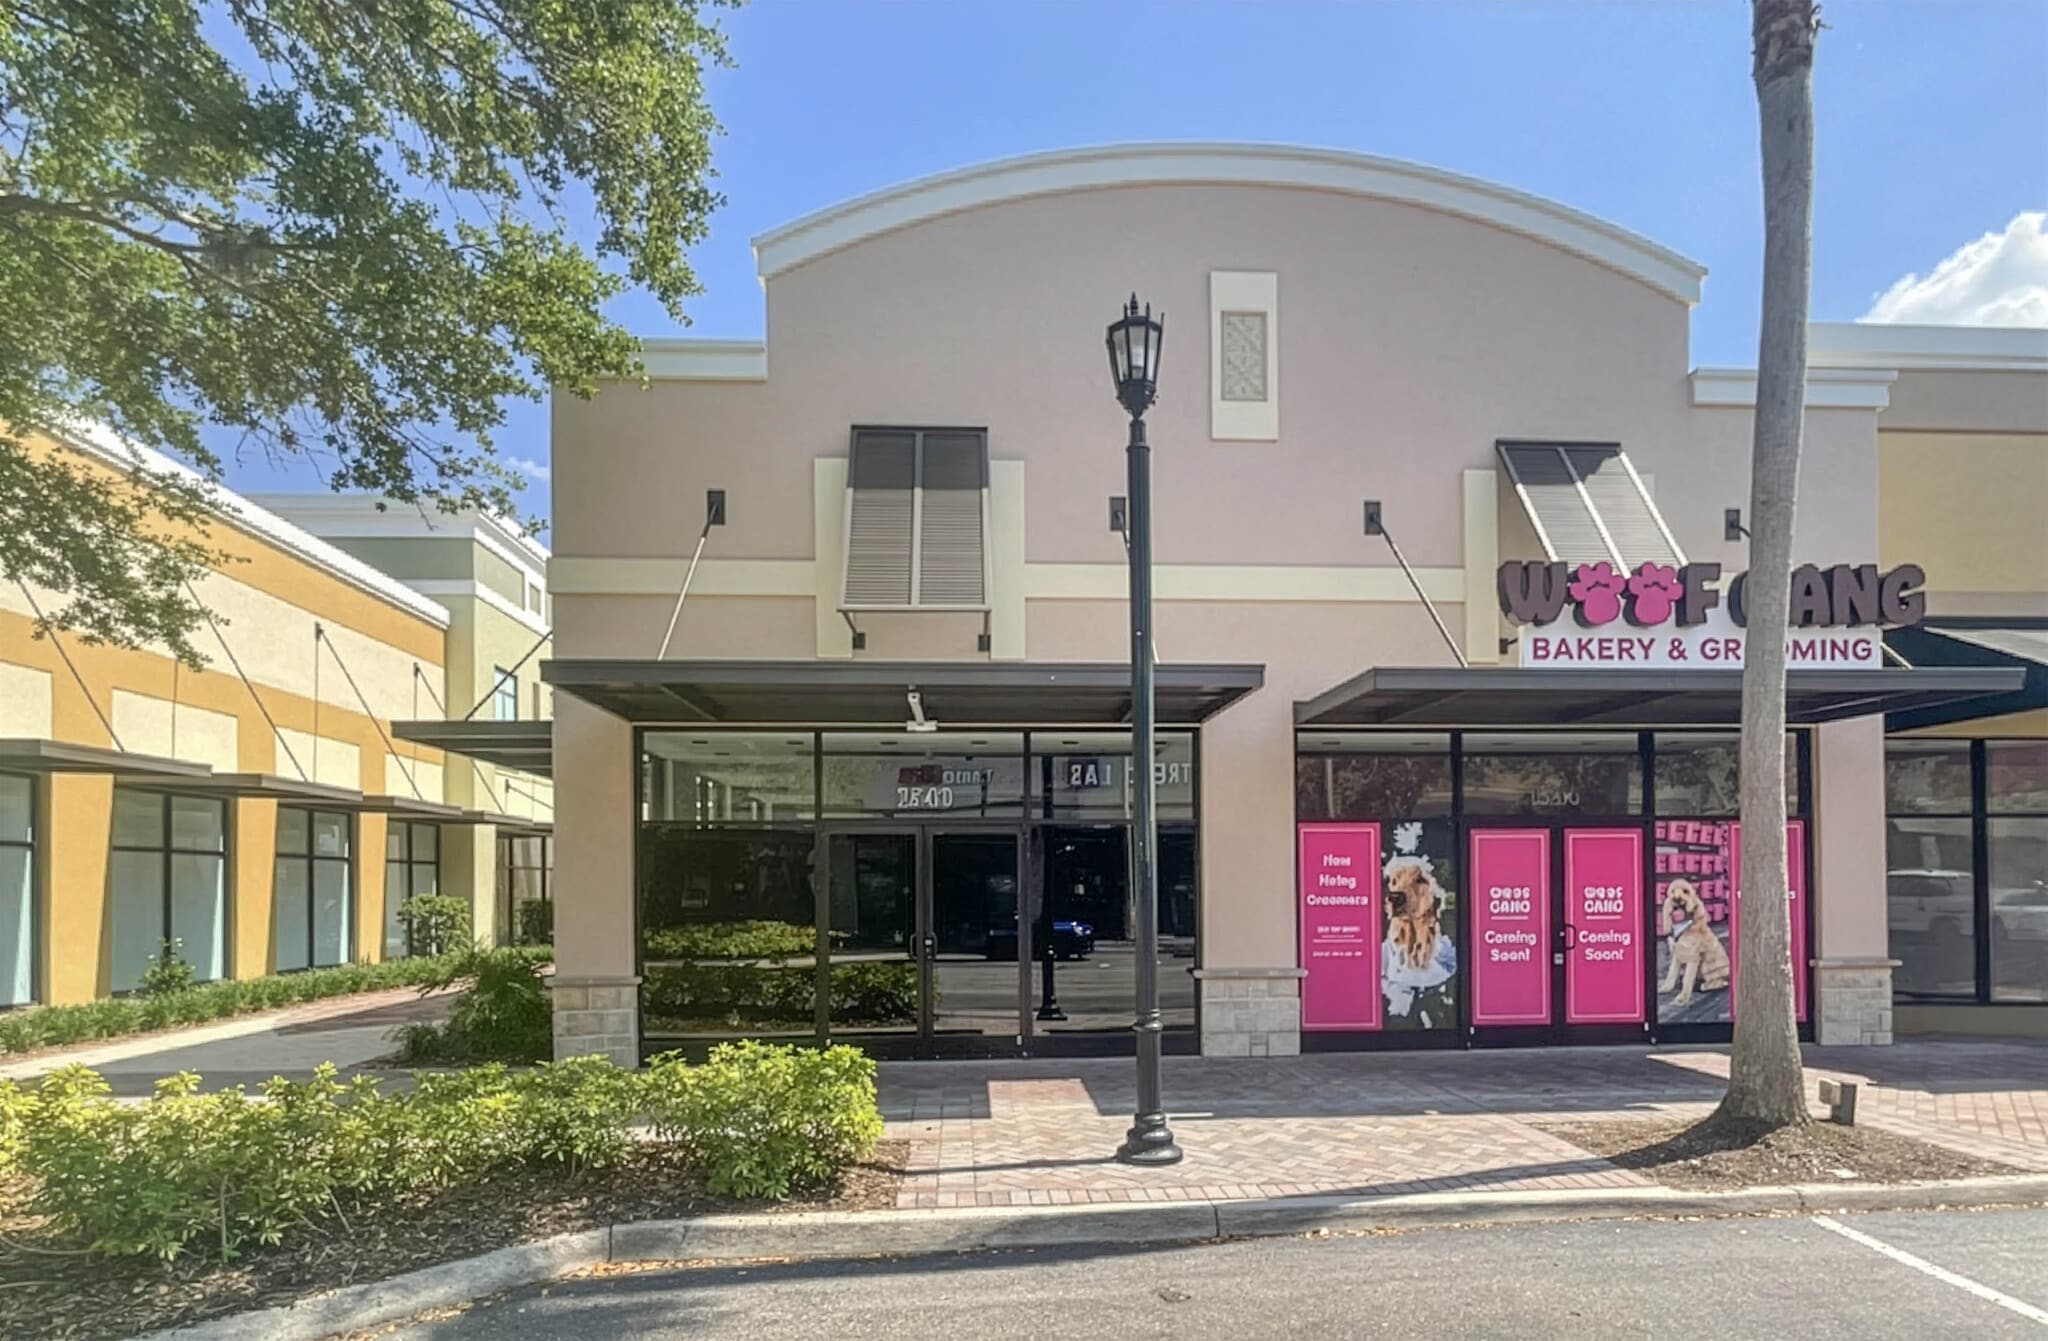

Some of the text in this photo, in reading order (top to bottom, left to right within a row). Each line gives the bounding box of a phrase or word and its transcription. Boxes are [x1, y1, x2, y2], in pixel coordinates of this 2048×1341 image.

[1531, 637, 1874, 662] BAKERY & GRMING
